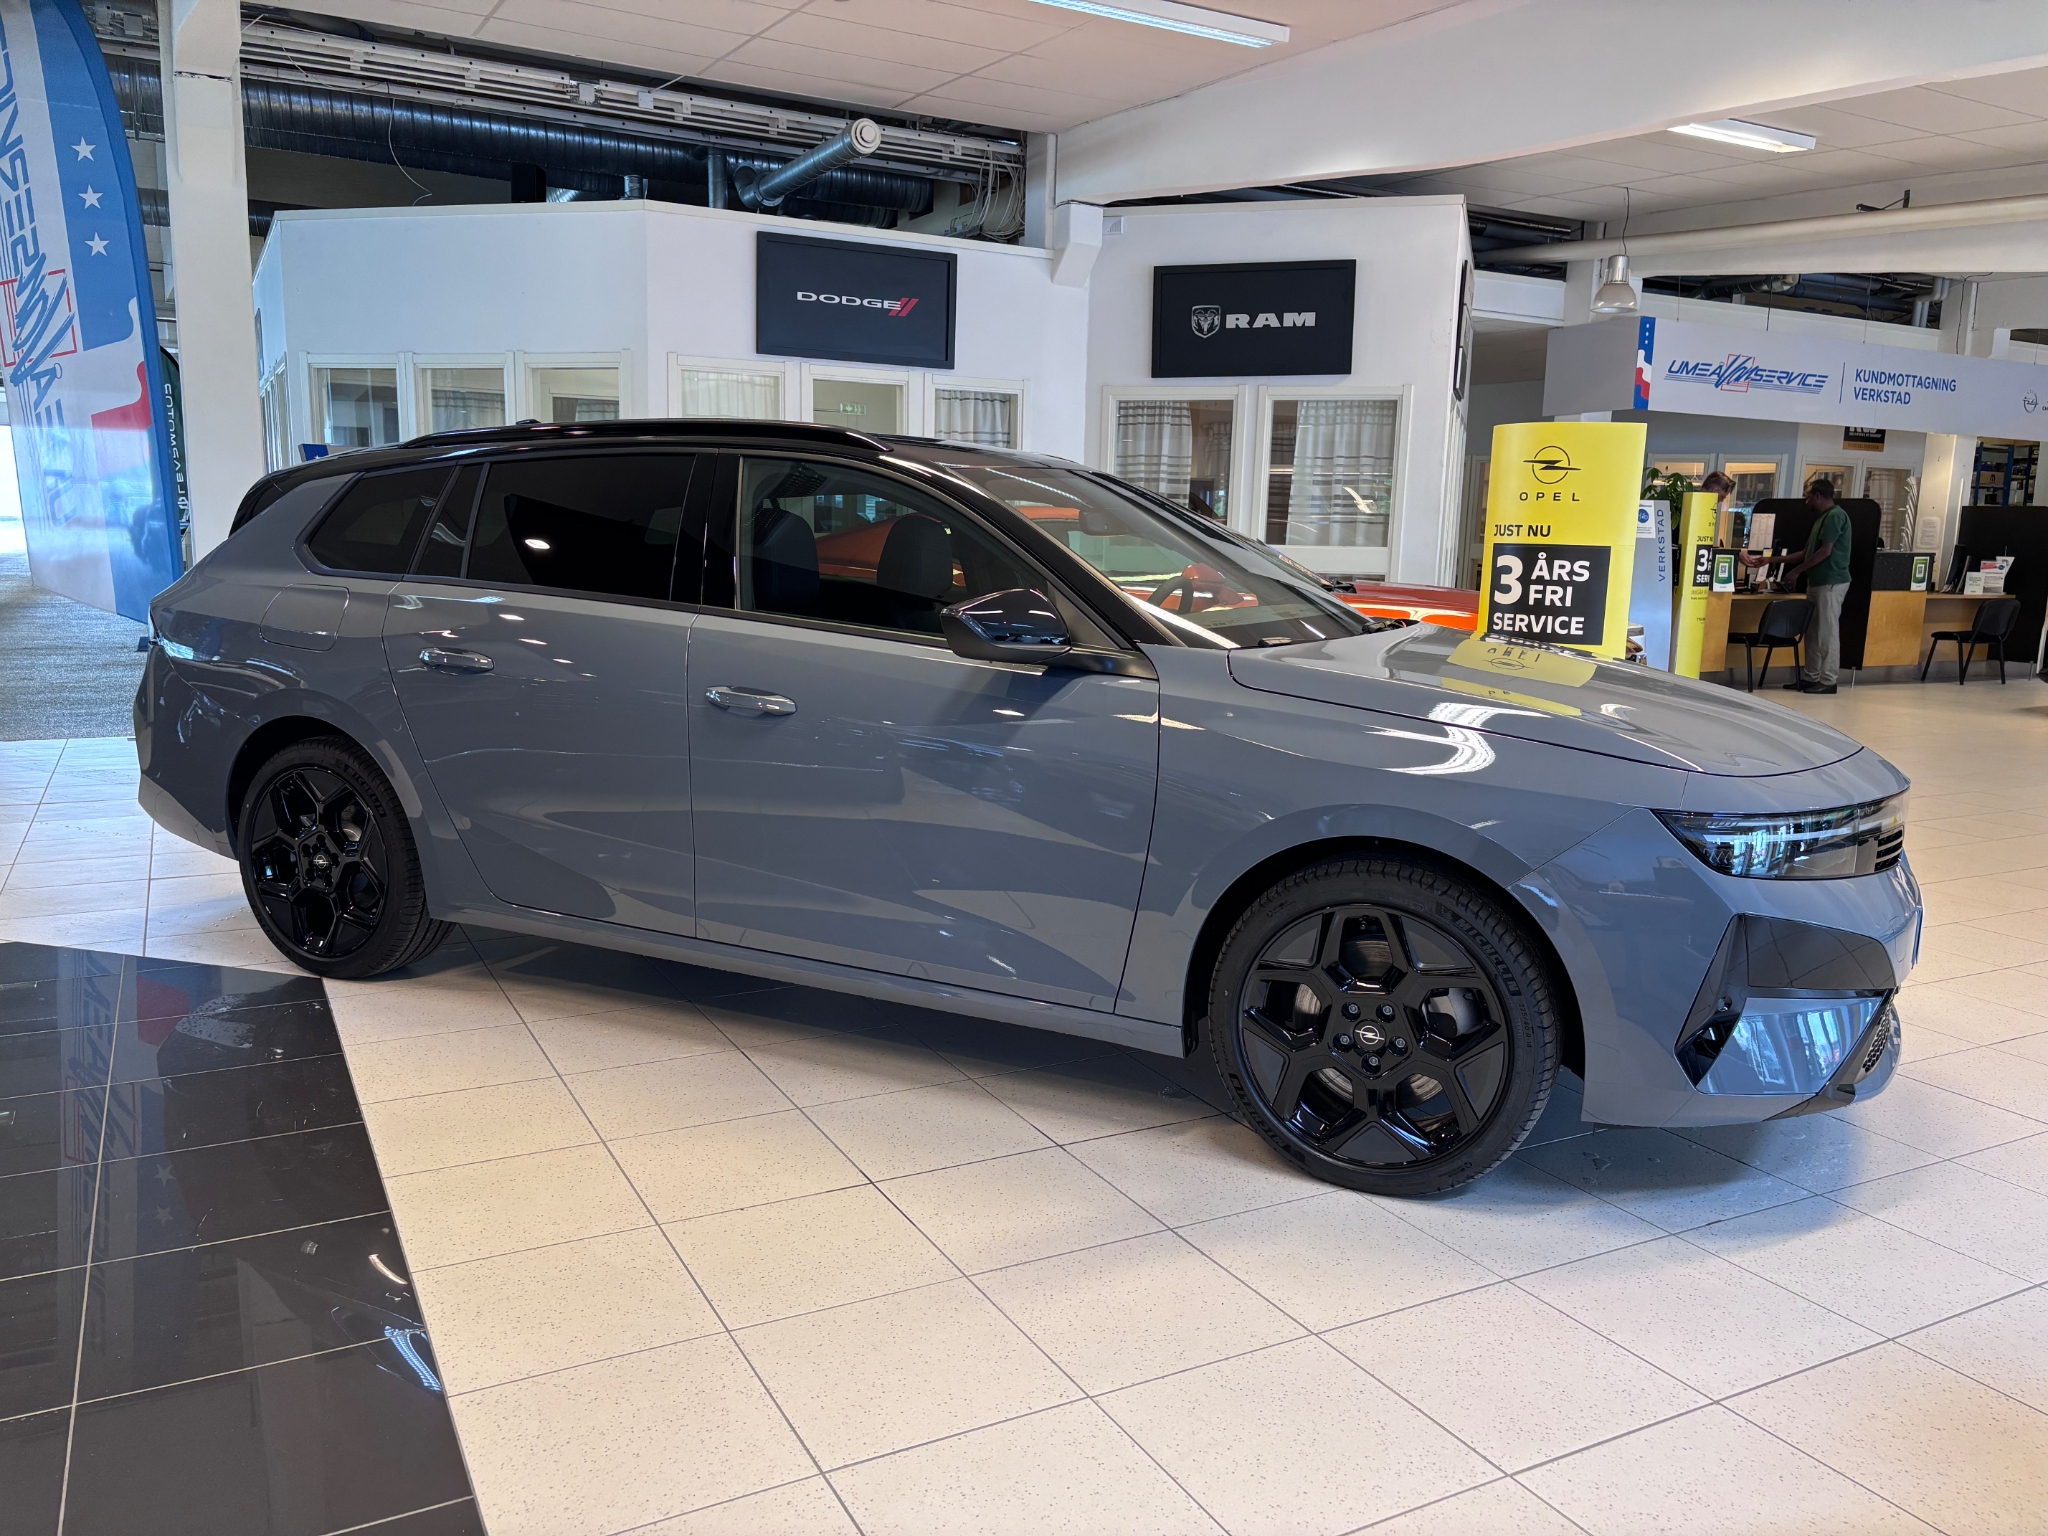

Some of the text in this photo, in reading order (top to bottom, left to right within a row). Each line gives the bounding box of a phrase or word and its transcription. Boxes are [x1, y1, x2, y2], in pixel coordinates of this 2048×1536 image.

[797, 291, 902, 310] DODGE
[1226, 312, 1316, 328] RAM
[1854, 368, 1957, 392] KUNDMOTTAGNING
[1853, 386, 1911, 404] VERKSTAD
[1519, 491, 1580, 502] OPEL
[1494, 524, 1552, 537] JUST NU
[1657, 509, 1666, 582] VERKSTAD
[1696, 549, 1708, 571] 3
[1494, 552, 1590, 604] 3 ÅRS
[1528, 584, 1573, 607] FRI
[1492, 612, 1585, 635] SERVICE
[1454, 917, 1521, 993] MICHELIN
